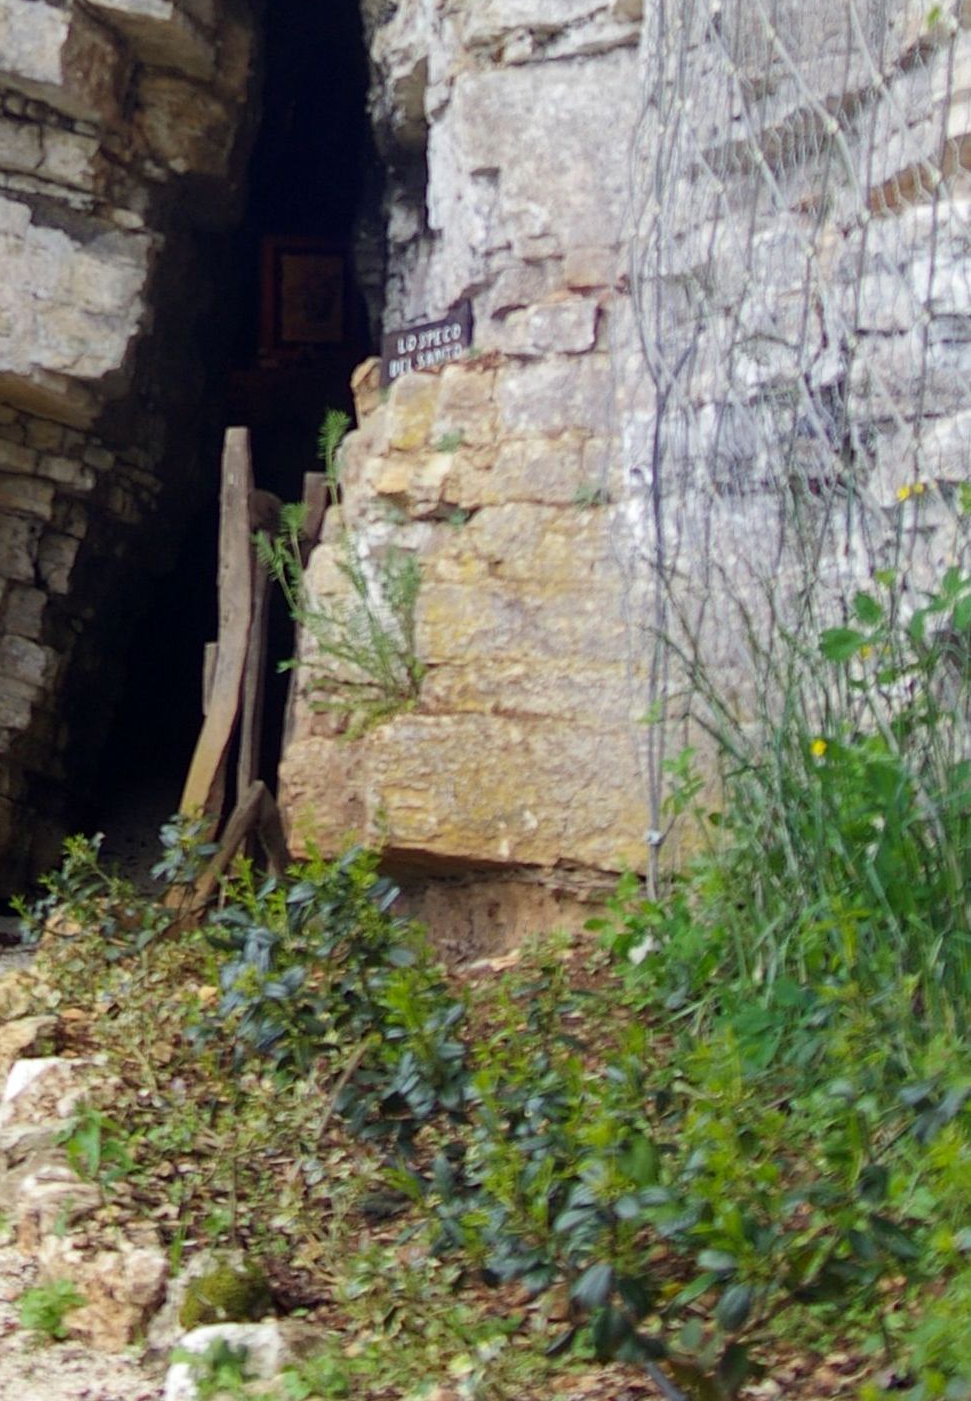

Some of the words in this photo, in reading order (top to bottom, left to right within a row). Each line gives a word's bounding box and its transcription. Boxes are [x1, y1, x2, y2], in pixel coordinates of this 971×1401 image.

[397, 335, 417, 354] LO
[418, 323, 462, 350] SPECO
[416, 343, 462, 370] SANTO
